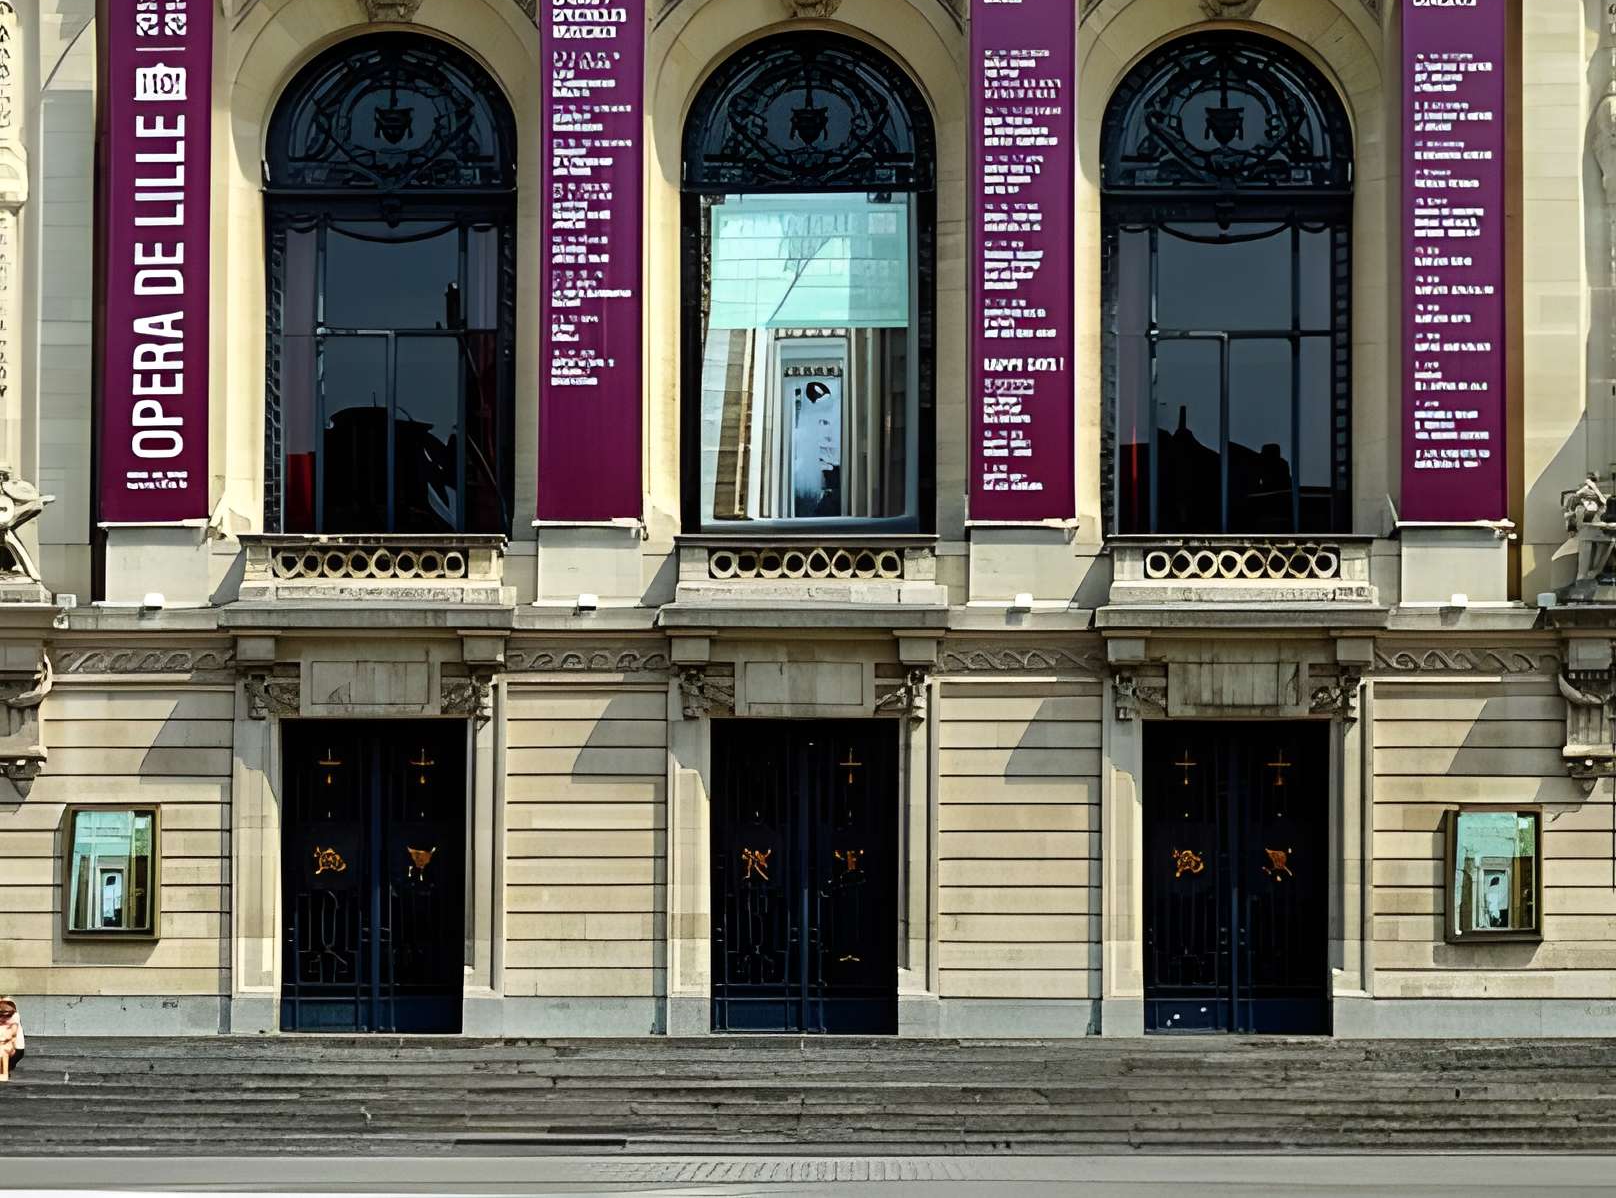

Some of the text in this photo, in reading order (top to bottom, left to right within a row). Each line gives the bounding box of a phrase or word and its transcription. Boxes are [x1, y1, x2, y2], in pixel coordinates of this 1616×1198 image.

[134, 114, 186, 226] LILLE
[133, 242, 185, 296] DE
[132, 310, 185, 459] OPERA
